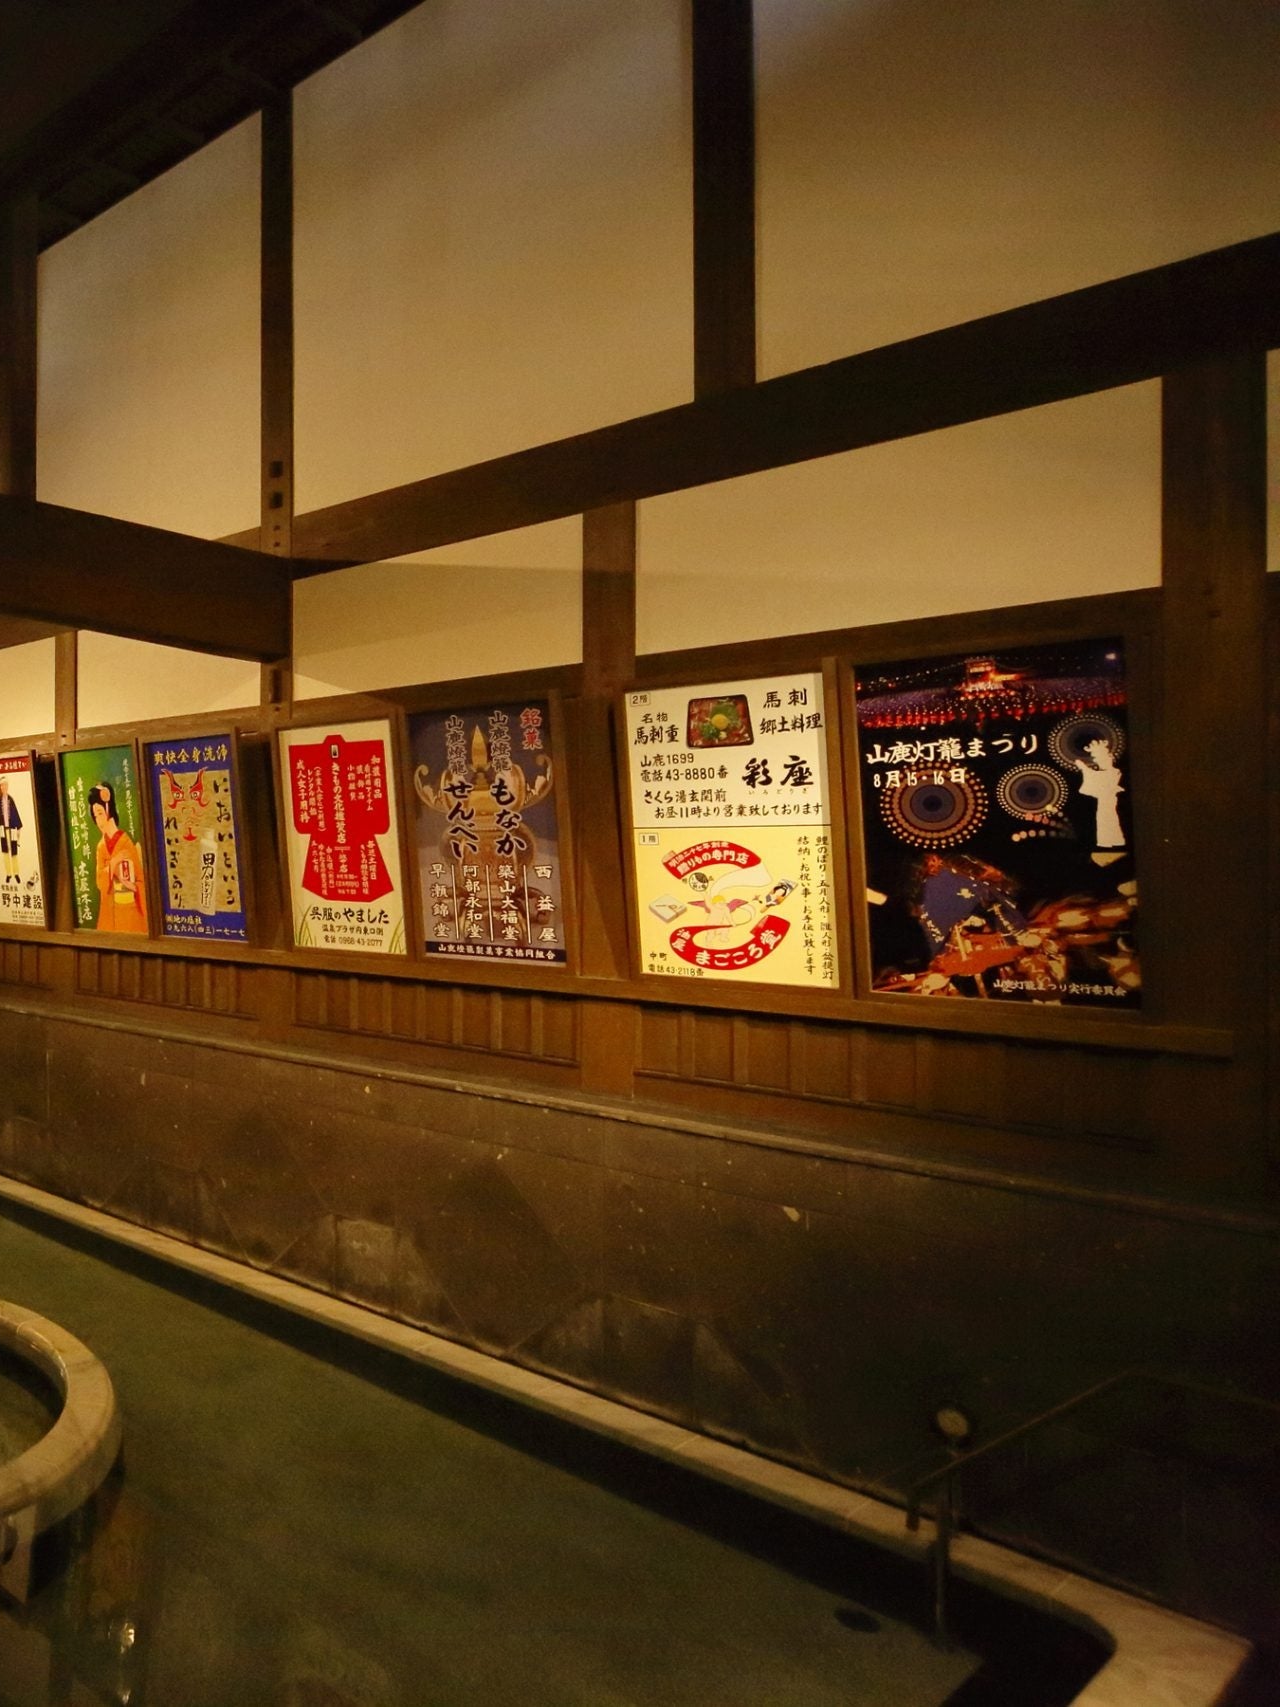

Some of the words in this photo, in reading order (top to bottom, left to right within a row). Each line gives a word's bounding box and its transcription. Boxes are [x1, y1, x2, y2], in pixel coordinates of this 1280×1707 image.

[632, 694, 648, 704] 2階
[763, 688, 807, 708] 馬刺
[642, 713, 668, 723] 名物
[760, 712, 823, 735] 郷土料理
[520, 708, 542, 750] 銘菓
[634, 724, 680, 745] 馬刺重
[866, 734, 1038, 764] 山鹿灯籠まつり
[640, 753, 694, 767] 山鹿1699
[640, 765, 728, 783] 電話43-8880番
[742, 755, 814, 789] 彩座
[644, 789, 727, 804] さくら湯玄関前
[655, 803, 822, 819] お昼11時より営業致しております
[430, 863, 451, 938] 早瀬錦堂
[462, 865, 484, 939] 阿部永和堂
[497, 864, 520, 941] 築山大福堂
[534, 864, 558, 942] 西益屋
[309, 906, 389, 924] 呉服のやました
[649, 952, 667, 961] 中町
